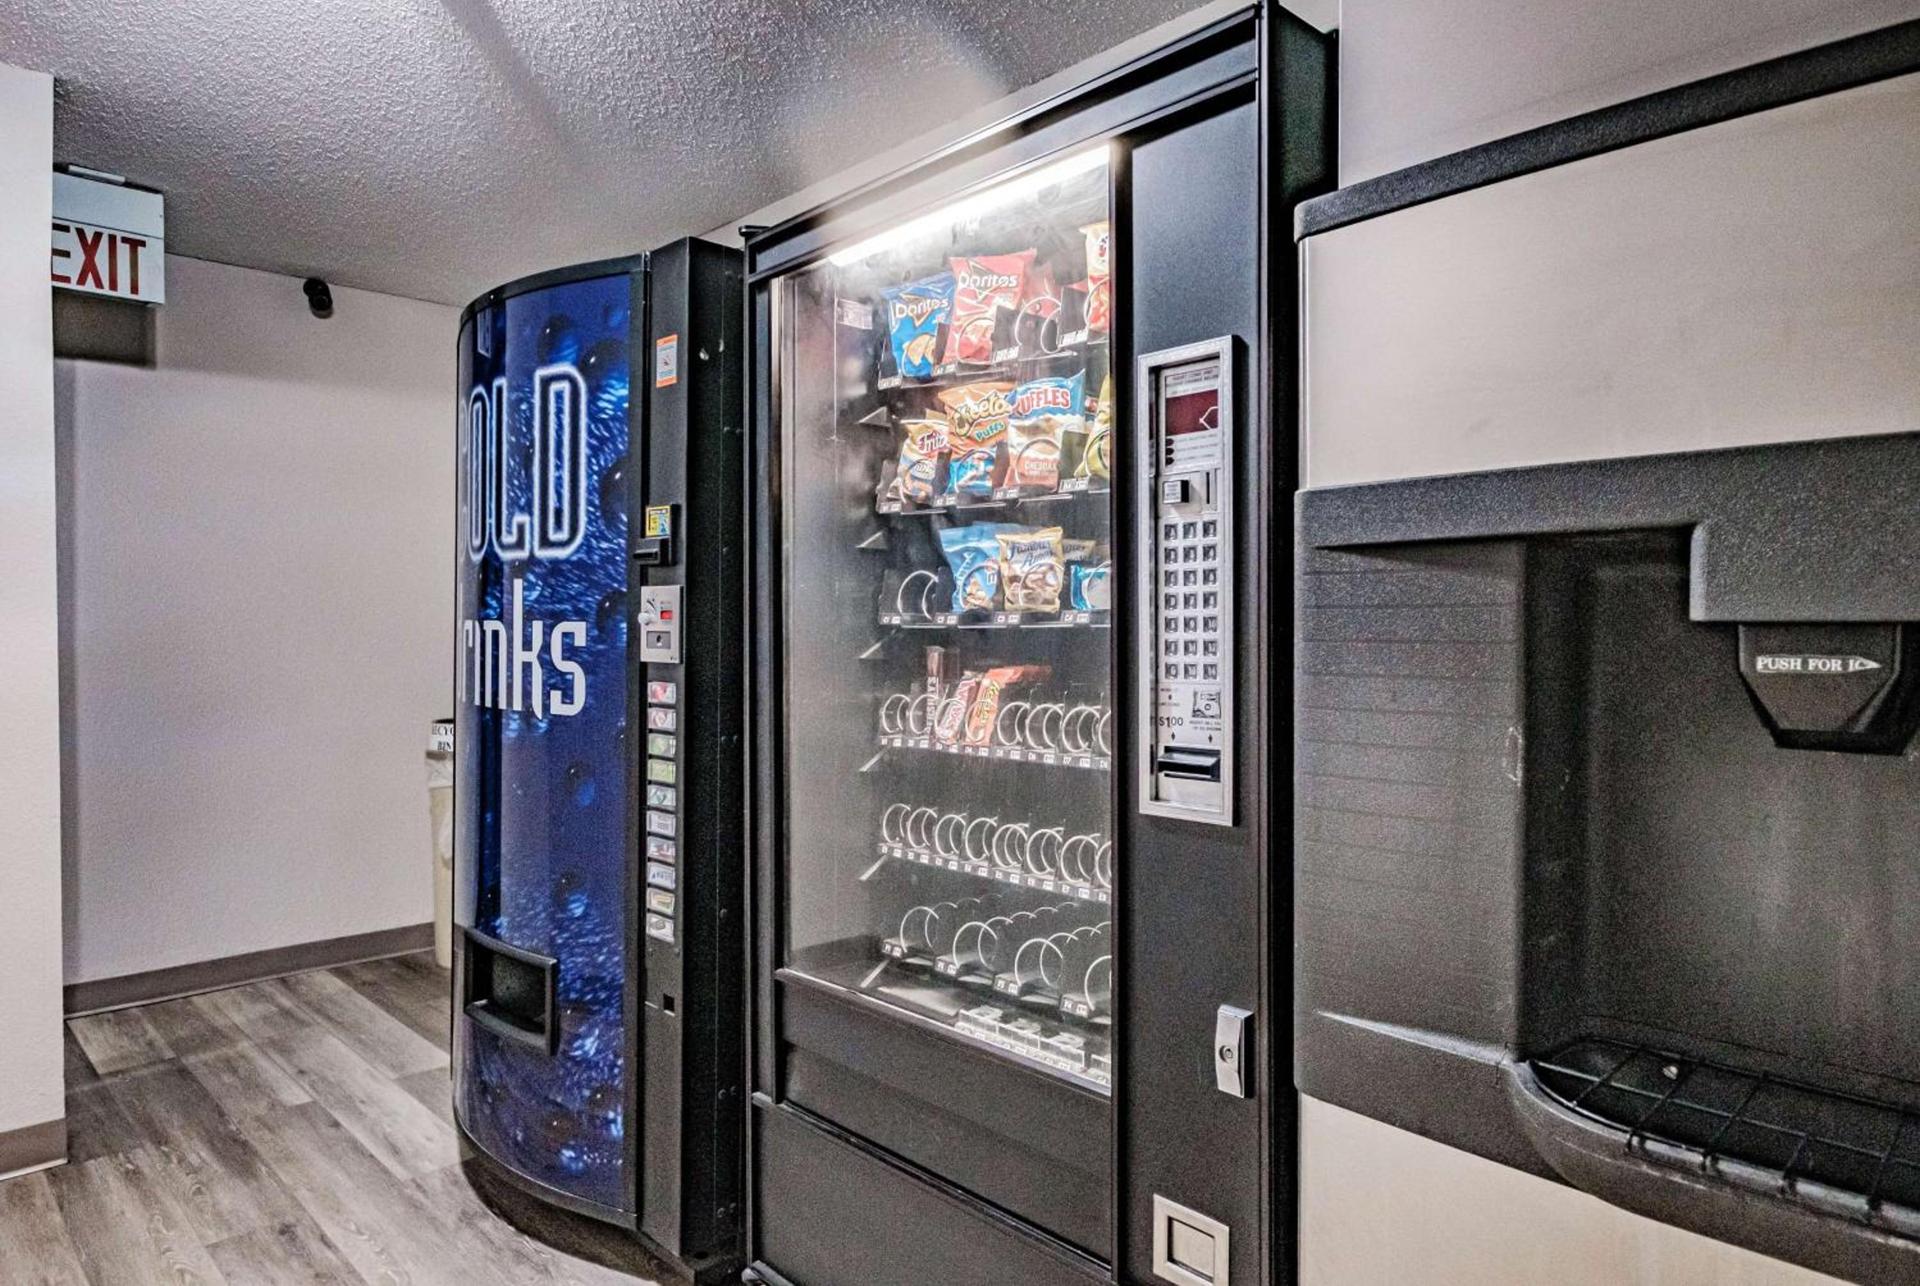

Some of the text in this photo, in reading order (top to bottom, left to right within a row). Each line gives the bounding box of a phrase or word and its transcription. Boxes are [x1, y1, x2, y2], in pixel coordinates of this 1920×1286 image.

[51, 222, 147, 296] EXIT
[957, 271, 1019, 289] Doritos
[895, 298, 950, 318] Doritos
[459, 364, 587, 560] OLD
[459, 578, 587, 720] rinks
[1756, 656, 1802, 672] PUSH
[1808, 657, 1842, 672] FOR
